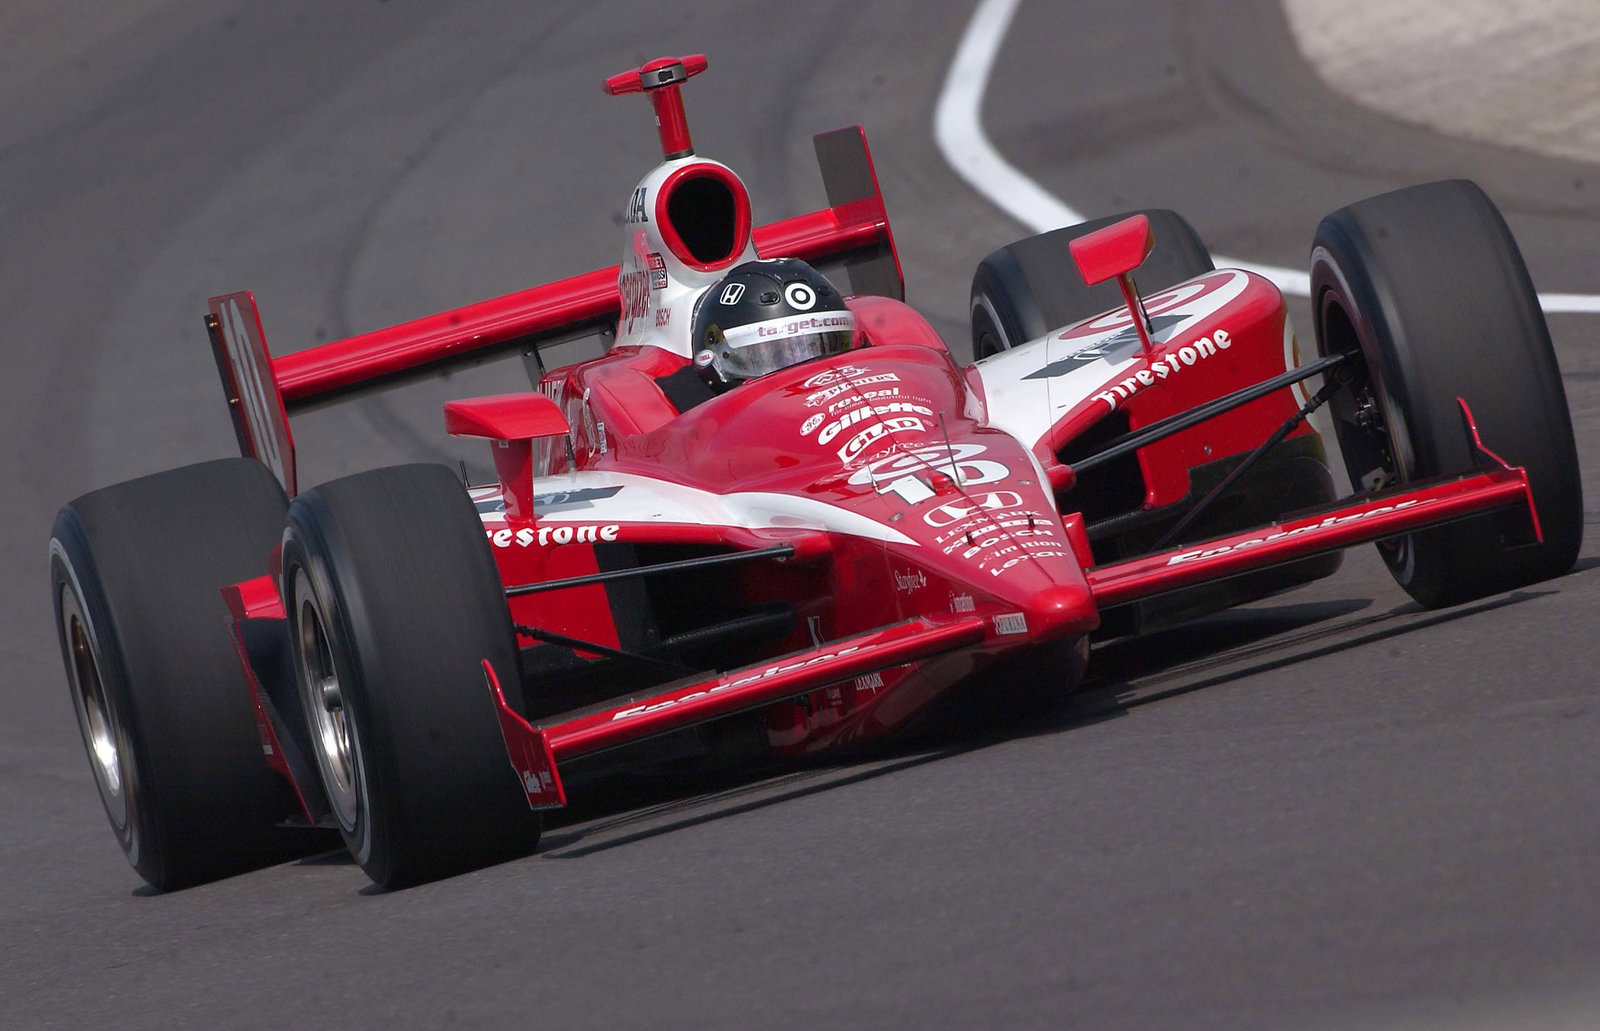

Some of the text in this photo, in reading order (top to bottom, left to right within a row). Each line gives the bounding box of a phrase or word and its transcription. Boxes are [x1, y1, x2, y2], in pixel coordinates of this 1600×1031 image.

[1091, 328, 1232, 411] Firestone
[828, 387, 899, 413] reveal
[818, 402, 933, 445] Gillette
[844, 419, 918, 458] GLAD
[486, 525, 620, 548] restone
[963, 530, 1053, 559] BOSCH
